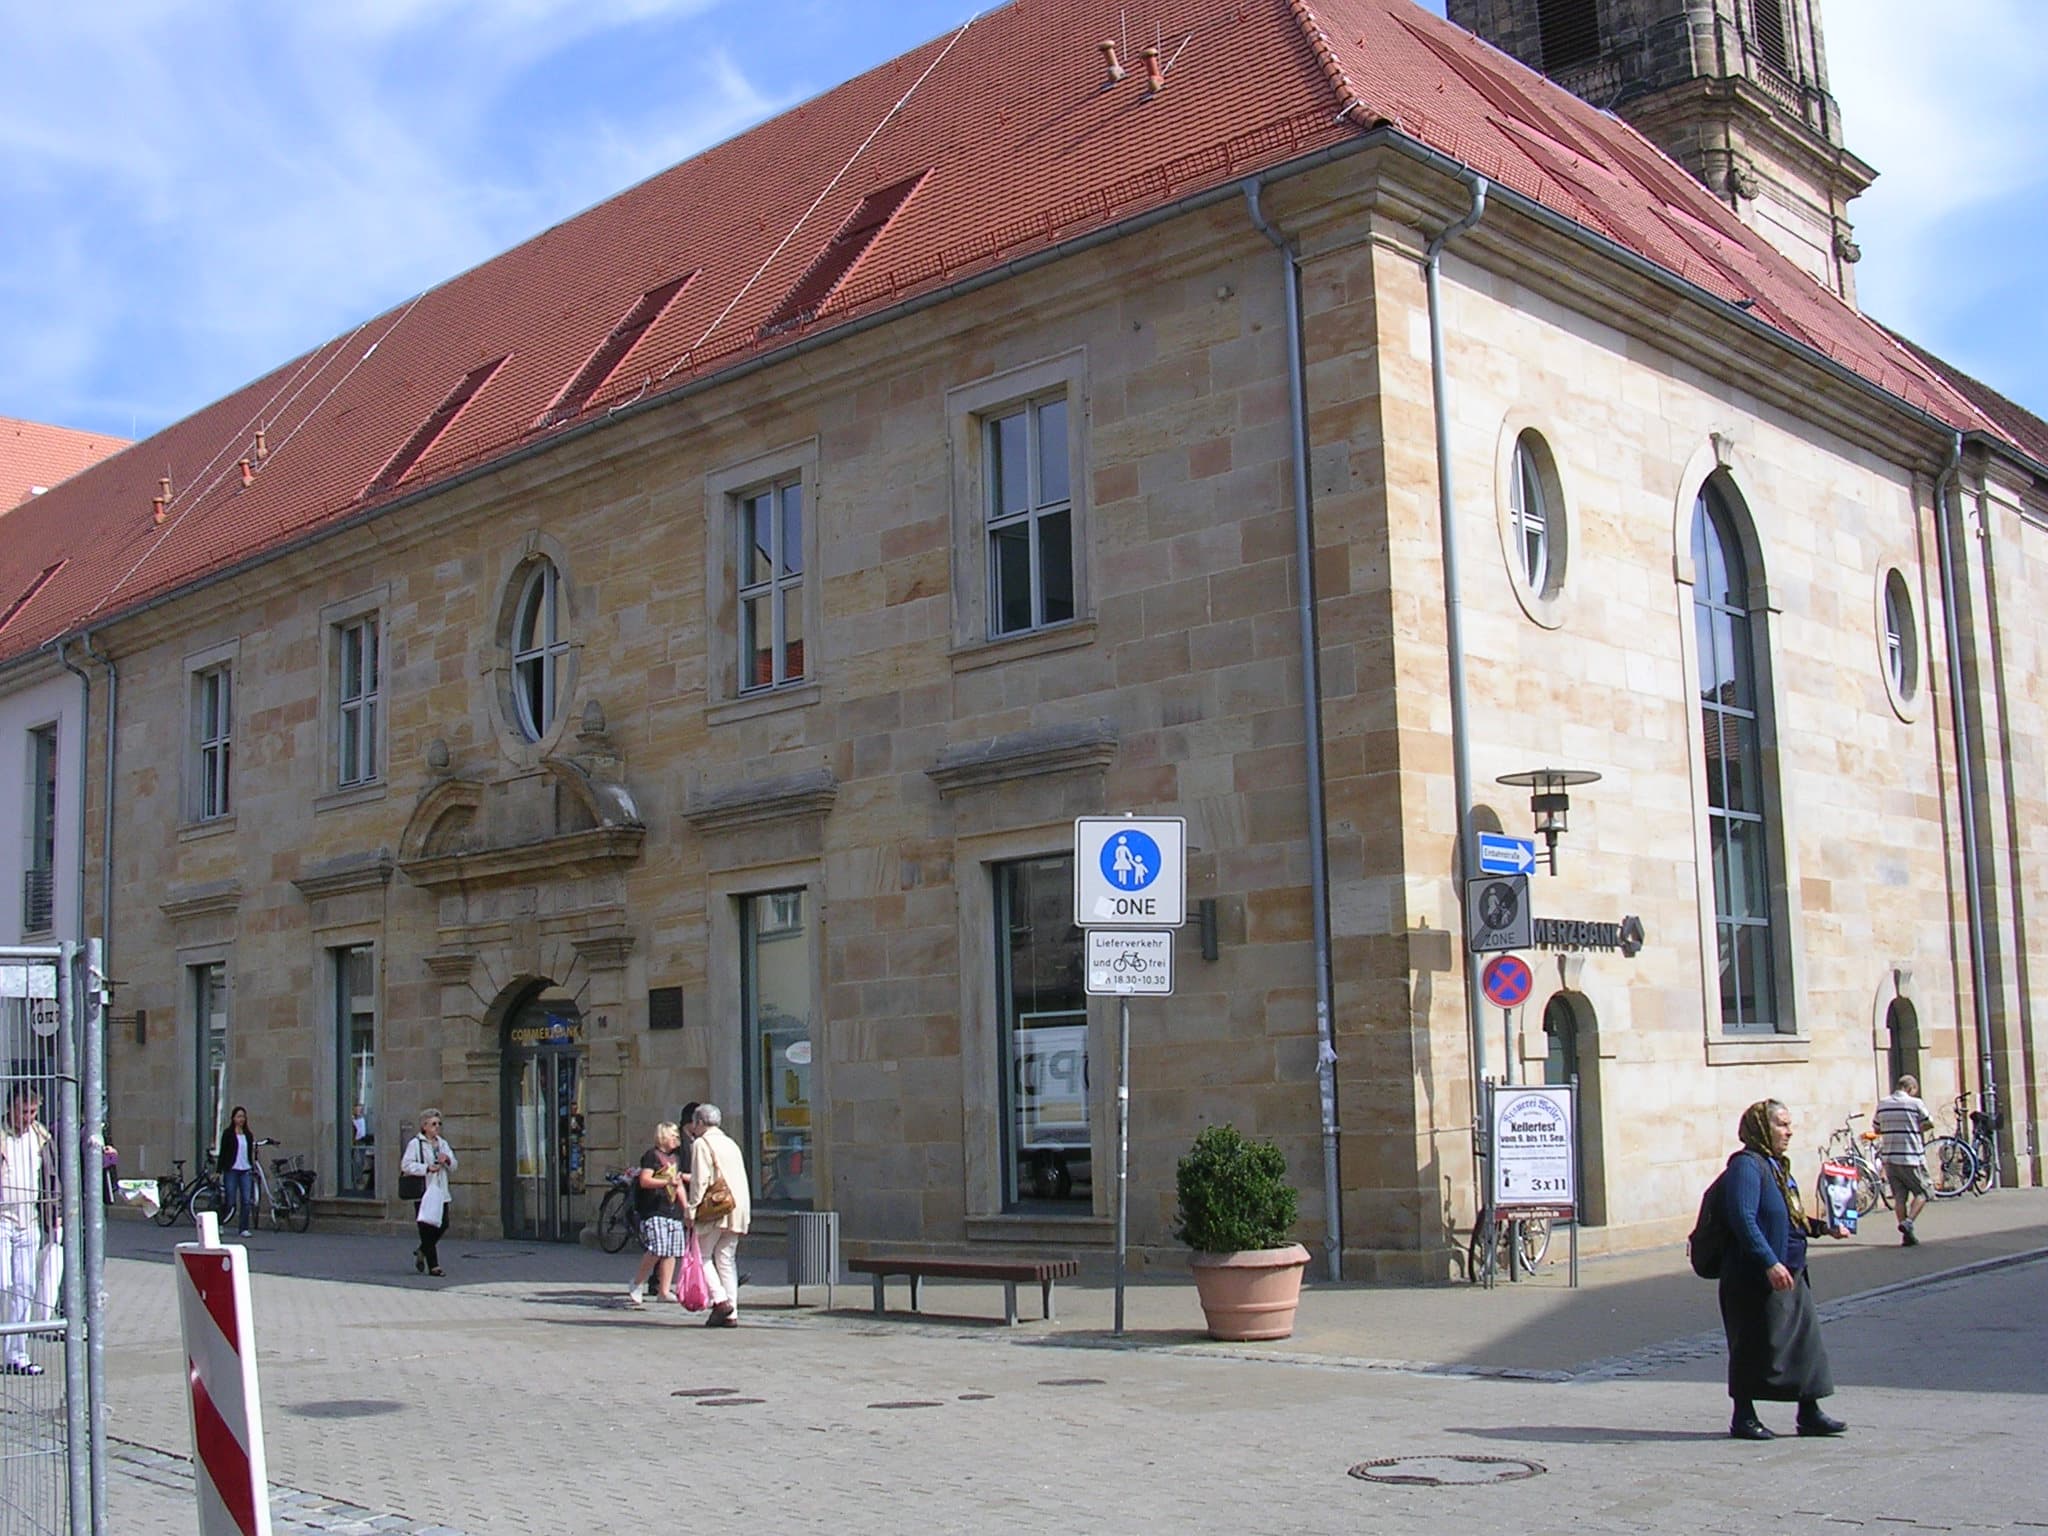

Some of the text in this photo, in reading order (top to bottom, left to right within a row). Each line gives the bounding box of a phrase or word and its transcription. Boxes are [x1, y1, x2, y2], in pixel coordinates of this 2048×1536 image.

[1096, 939, 1163, 948] Lieferverkehr
[1485, 932, 1516, 946] ZONE
[1093, 959, 1166, 967] und frei
[1511, 1121, 1556, 1133] Kellerfest
[1501, 1135, 1517, 1143] vom
[1526, 1134, 1538, 1142] bis
